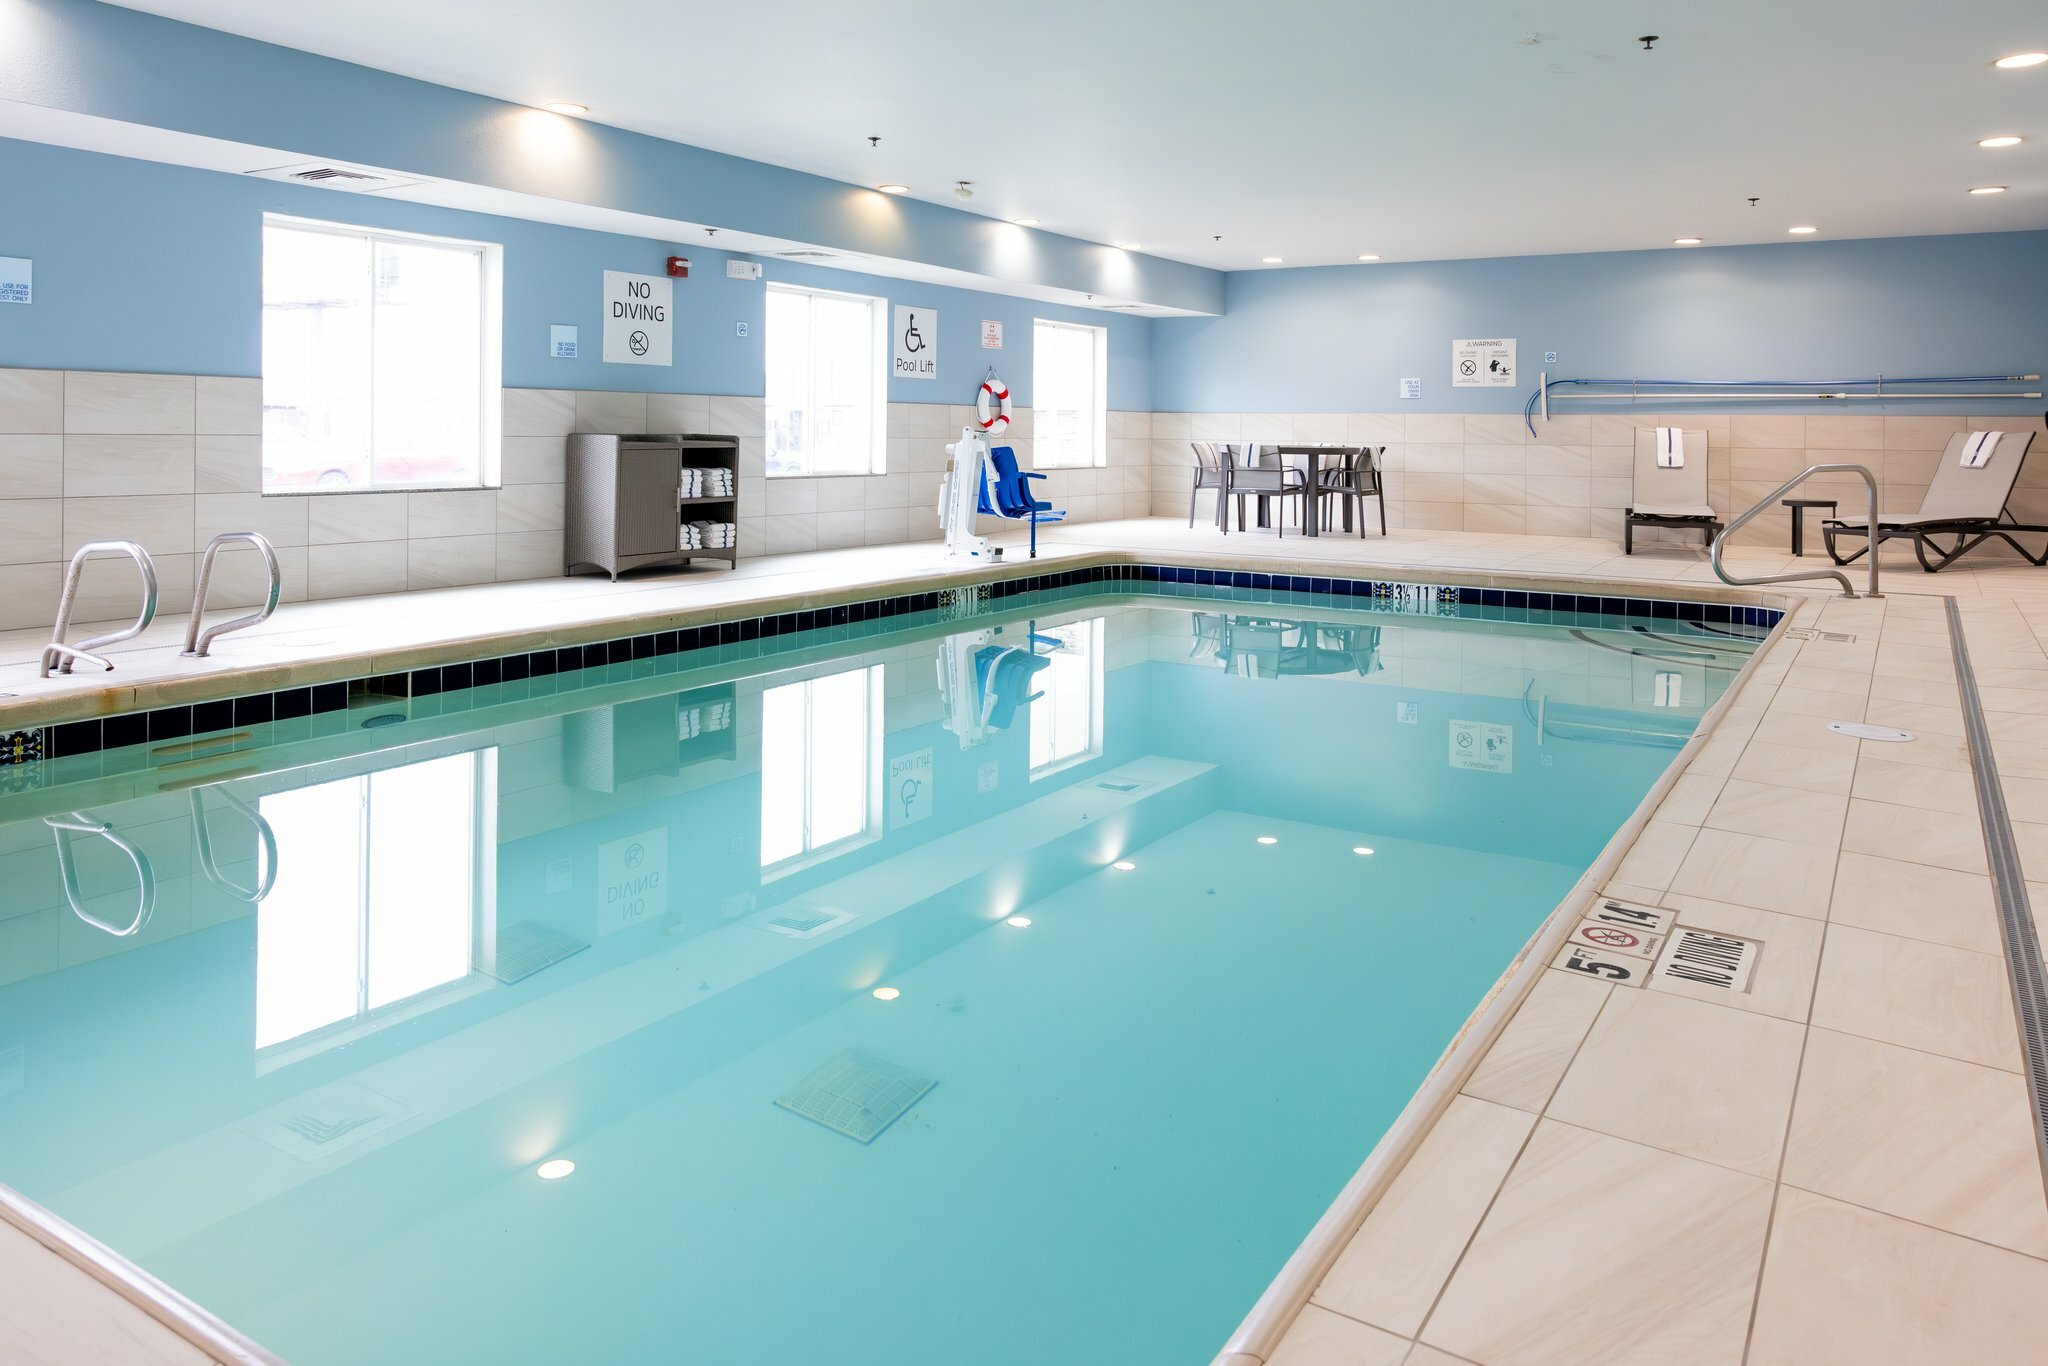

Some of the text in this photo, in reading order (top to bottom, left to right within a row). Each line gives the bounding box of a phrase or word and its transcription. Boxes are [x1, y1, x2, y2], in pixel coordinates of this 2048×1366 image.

[629, 281, 650, 298] NO
[613, 302, 664, 322] DIVING
[897, 358, 933, 373] Pool Lift
[1598, 905, 1660, 928] 1.4
[1645, 938, 1657, 949] DIVING
[1565, 948, 1631, 979] 5 FT
[1665, 932, 1745, 989] NO DIVING
